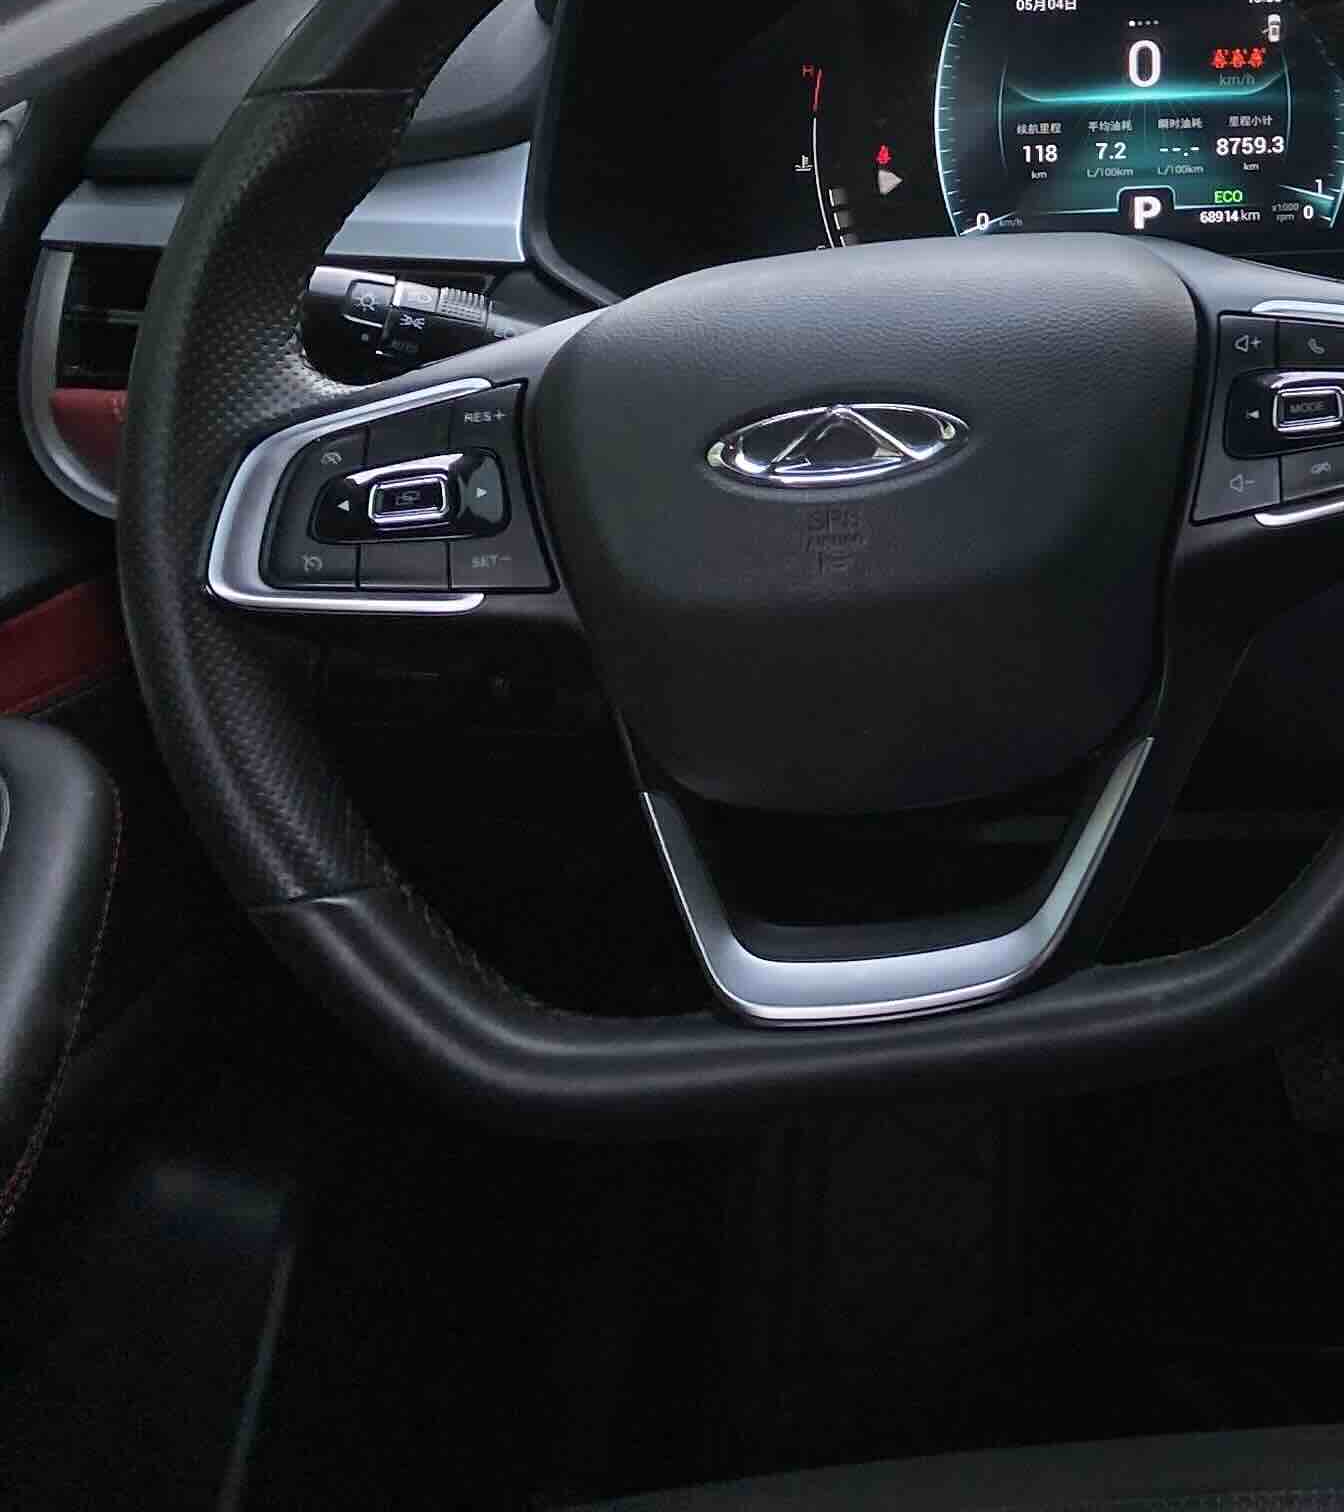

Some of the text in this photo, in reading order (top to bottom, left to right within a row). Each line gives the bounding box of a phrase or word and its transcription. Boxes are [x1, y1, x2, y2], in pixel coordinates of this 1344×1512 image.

[1128, 40, 1161, 87] 0
[1022, 144, 1058, 163] 118
[1094, 142, 1127, 161] 7.2
[1215, 136, 1285, 156] 8759.3
[1214, 190, 1243, 204] ECO
[976, 212, 989, 230] 0
[1133, 196, 1161, 230] P
[1200, 209, 1261, 224] 68914 km
[1303, 205, 1314, 220] 0
